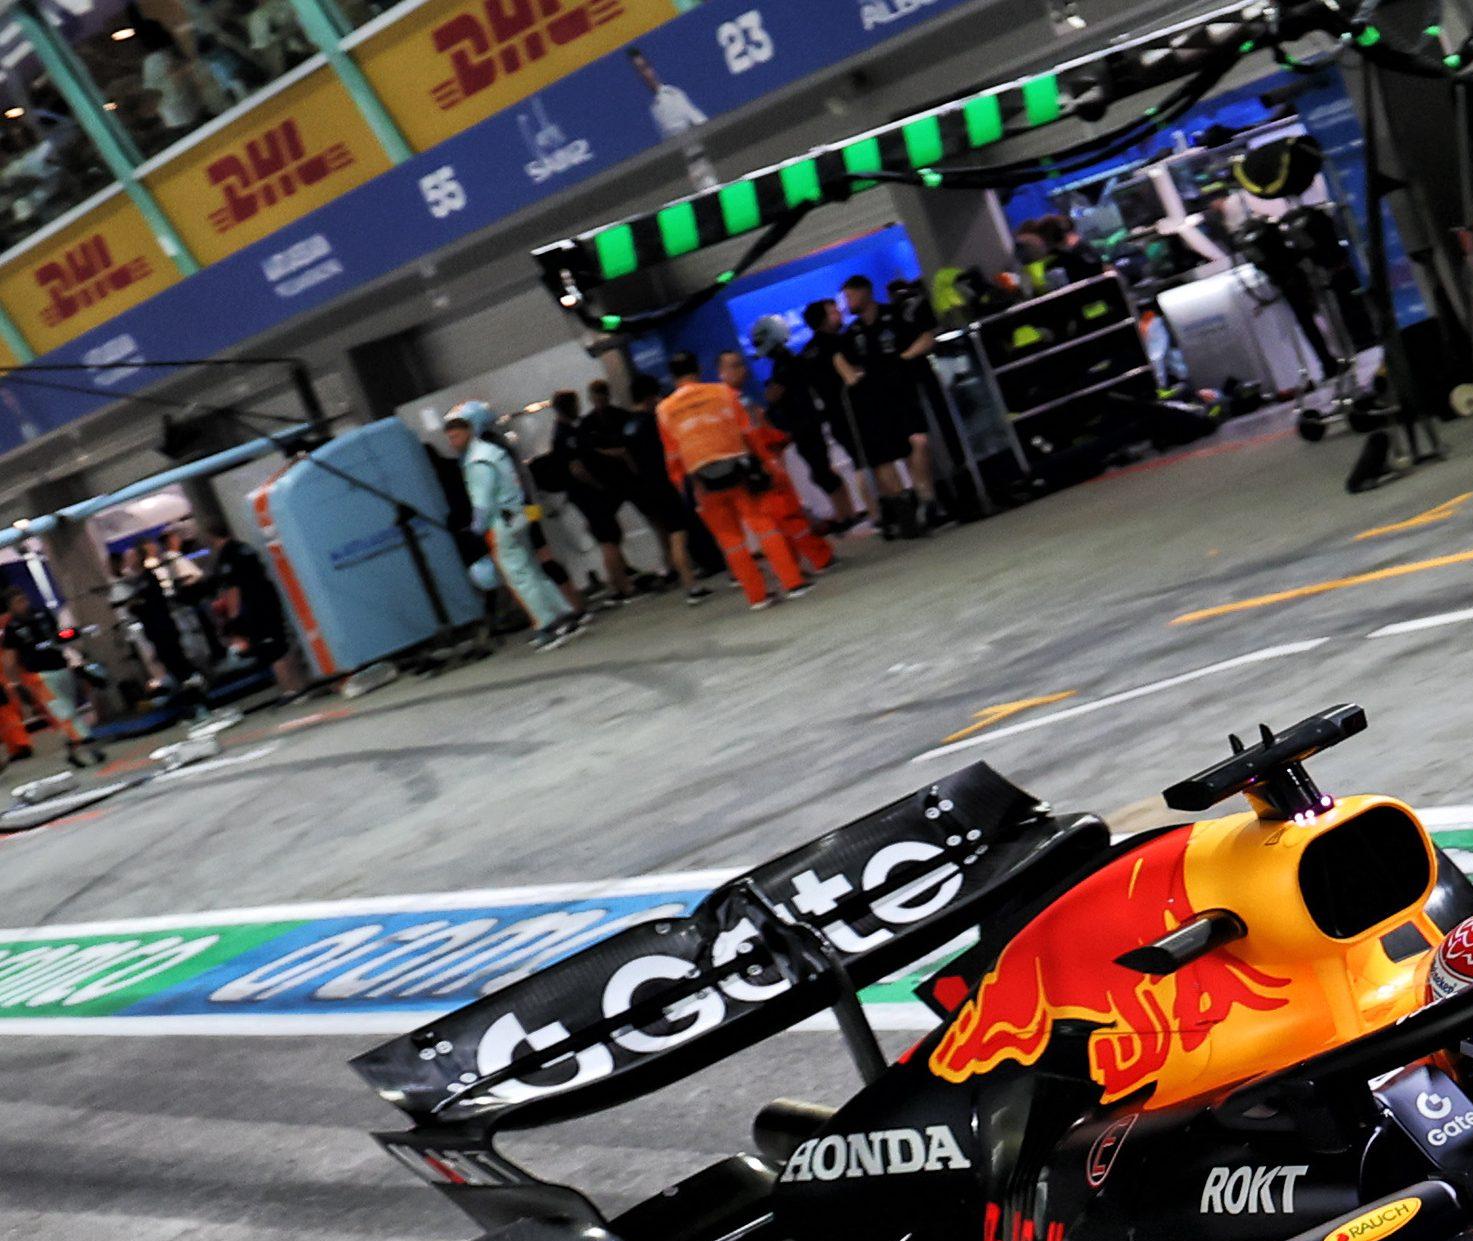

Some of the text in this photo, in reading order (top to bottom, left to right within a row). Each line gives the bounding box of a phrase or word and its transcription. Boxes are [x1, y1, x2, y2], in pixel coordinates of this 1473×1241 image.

[716, 10, 775, 75] 23
[207, 117, 330, 223] DHL
[419, 165, 468, 218] 55
[34, 233, 134, 320] DHL
[780, 1125, 970, 1184] HONDA
[1200, 1164, 1310, 1215] ROKT
[1348, 1203, 1410, 1239] RAUCH
